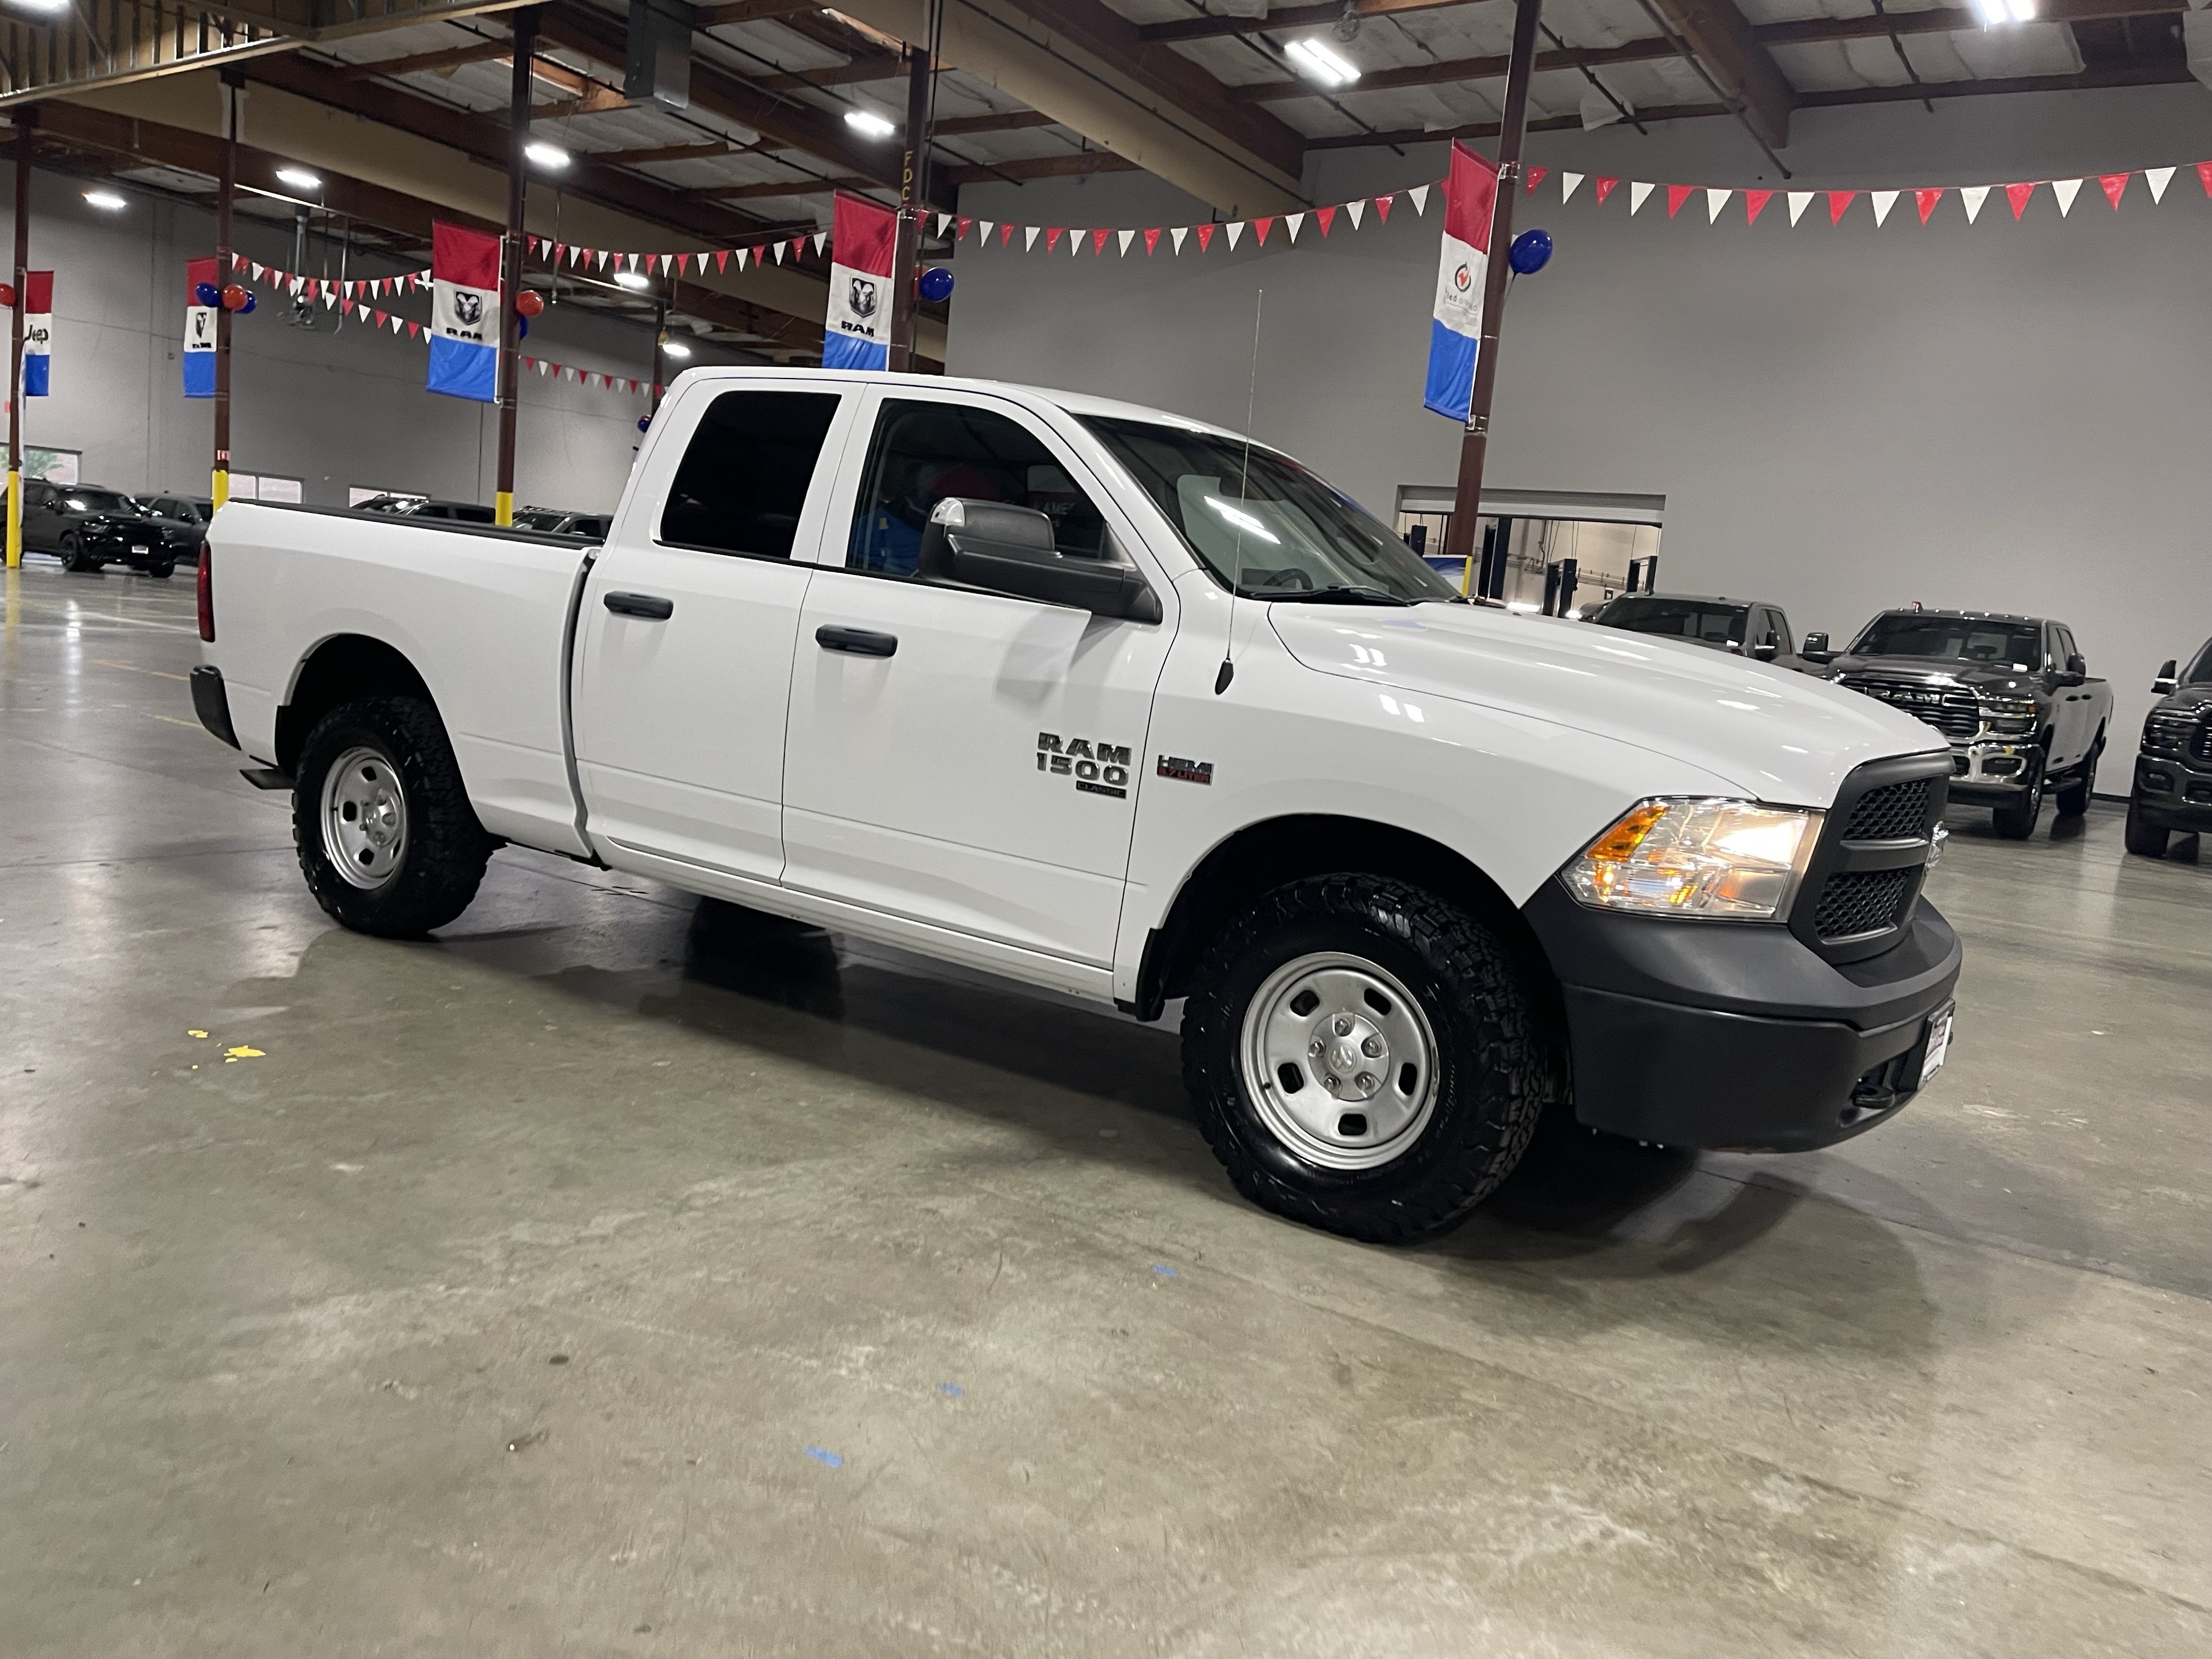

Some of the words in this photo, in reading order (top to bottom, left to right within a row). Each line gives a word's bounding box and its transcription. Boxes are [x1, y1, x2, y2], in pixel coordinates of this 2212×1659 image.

[902, 150, 914, 201] FDC
[446, 327, 483, 341] RAM
[841, 320, 874, 337] RAM
[1038, 732, 1132, 766] RAM
[1037, 752, 1129, 786] 1500
[1077, 782, 1125, 797] CLASSIC
